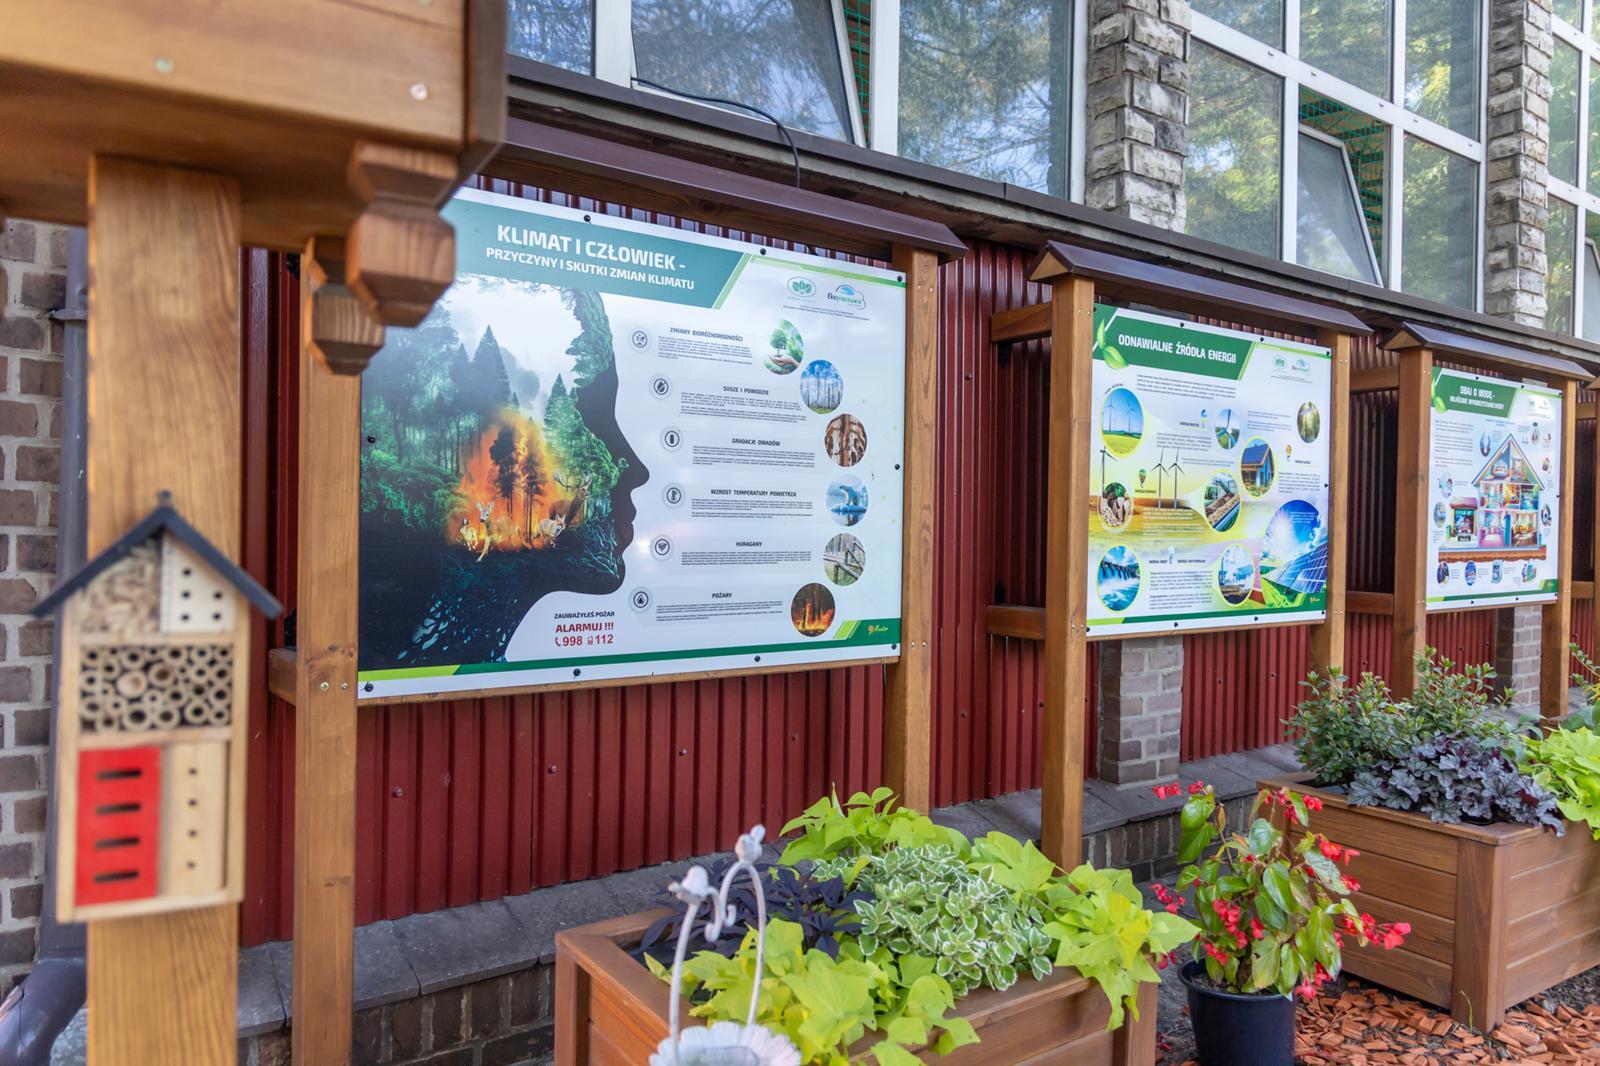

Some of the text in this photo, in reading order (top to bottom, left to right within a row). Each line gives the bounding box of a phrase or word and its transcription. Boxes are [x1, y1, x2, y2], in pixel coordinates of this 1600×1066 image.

[497, 224, 572, 253] KLIMAT
[575, 240, 581, 255] I
[585, 240, 676, 271] CZŁOWIEK
[486, 247, 695, 290] PRZYCZYNY I SKUTKI ZMIAN KLIMATU
[1118, 334, 1237, 364] ODNAWIALNE ŹRÓDŁA ENERGII
[723, 385, 739, 393] SUSZE
[731, 438, 781, 447] GRADACJE OWADÓW
[733, 489, 768, 497] TEMPERATURY
[595, 610, 615, 618] POŻAR
[555, 621, 614, 633] ALARMUJ !!!
[562, 633, 614, 647] 998 112
